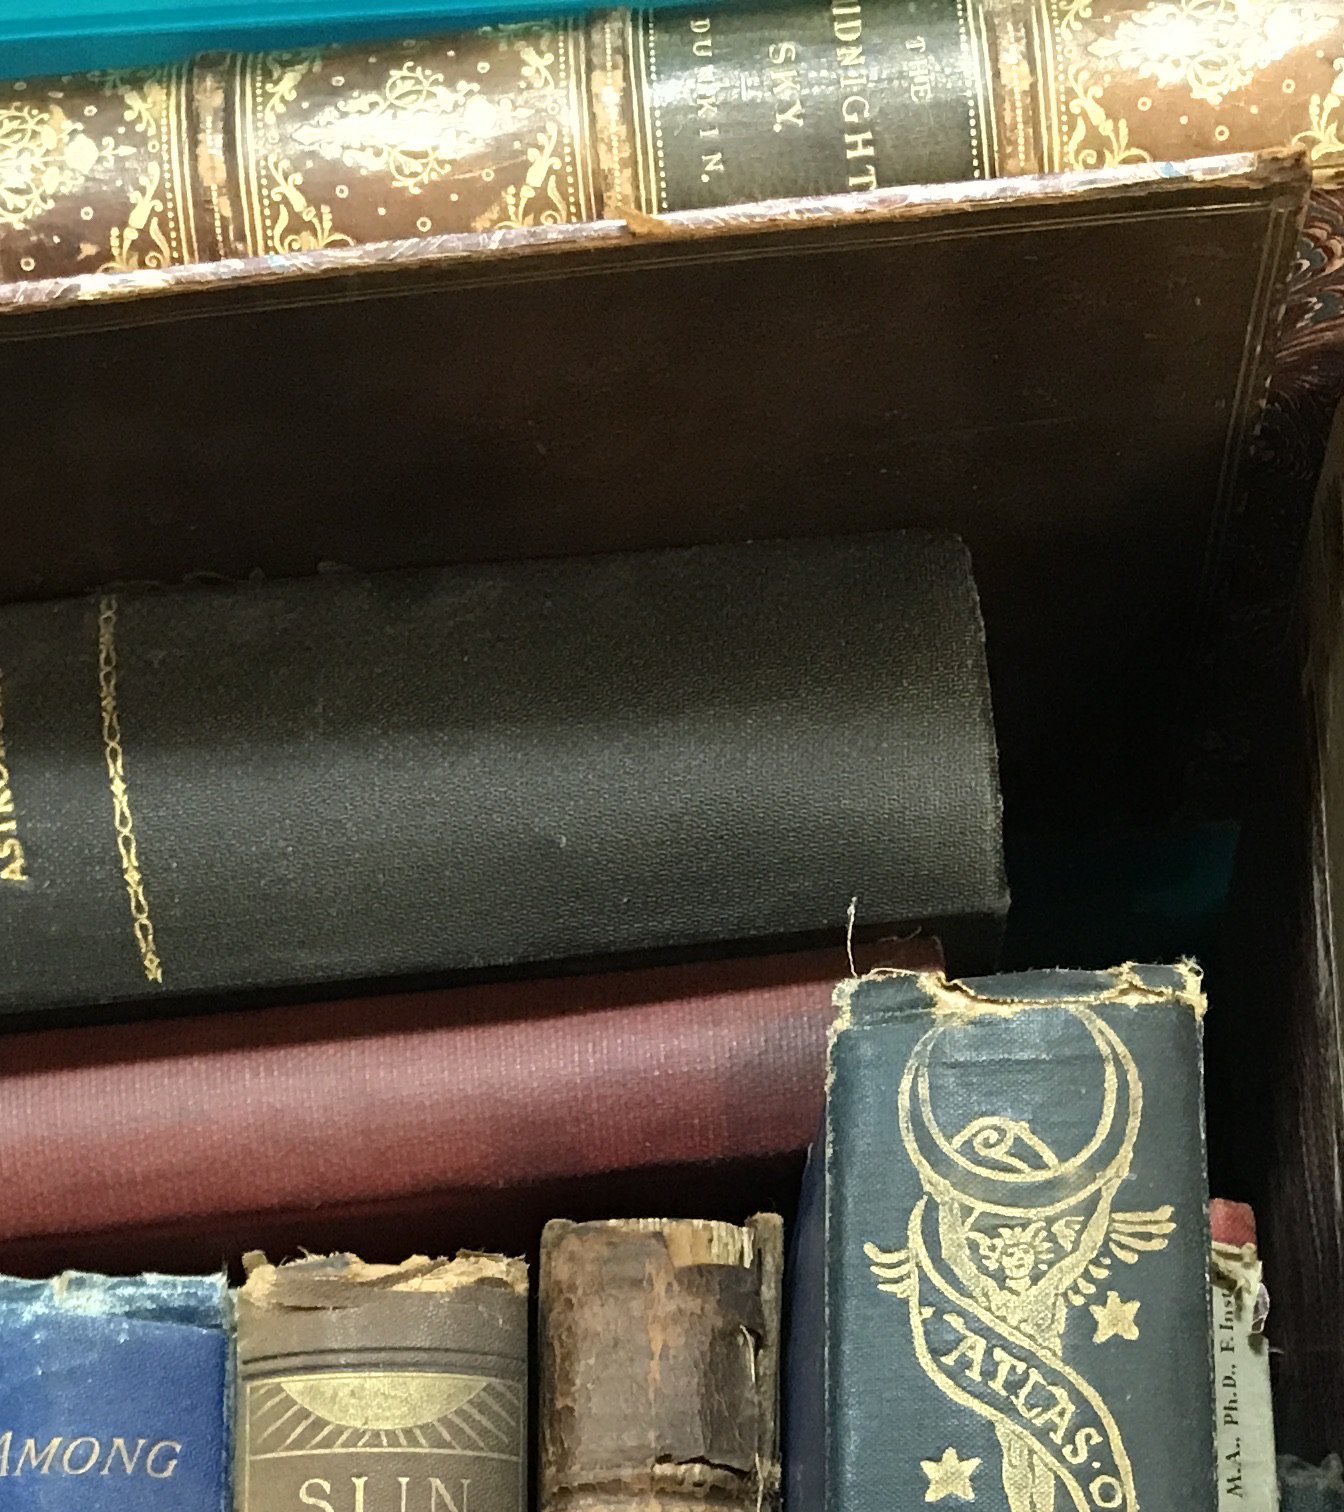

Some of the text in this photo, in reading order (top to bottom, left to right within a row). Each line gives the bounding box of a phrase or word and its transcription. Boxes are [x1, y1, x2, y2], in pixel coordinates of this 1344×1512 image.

[768, 41, 805, 134] SKY.
[829, 2, 878, 190] IDNIGHT
[904, 37, 933, 103] THE
